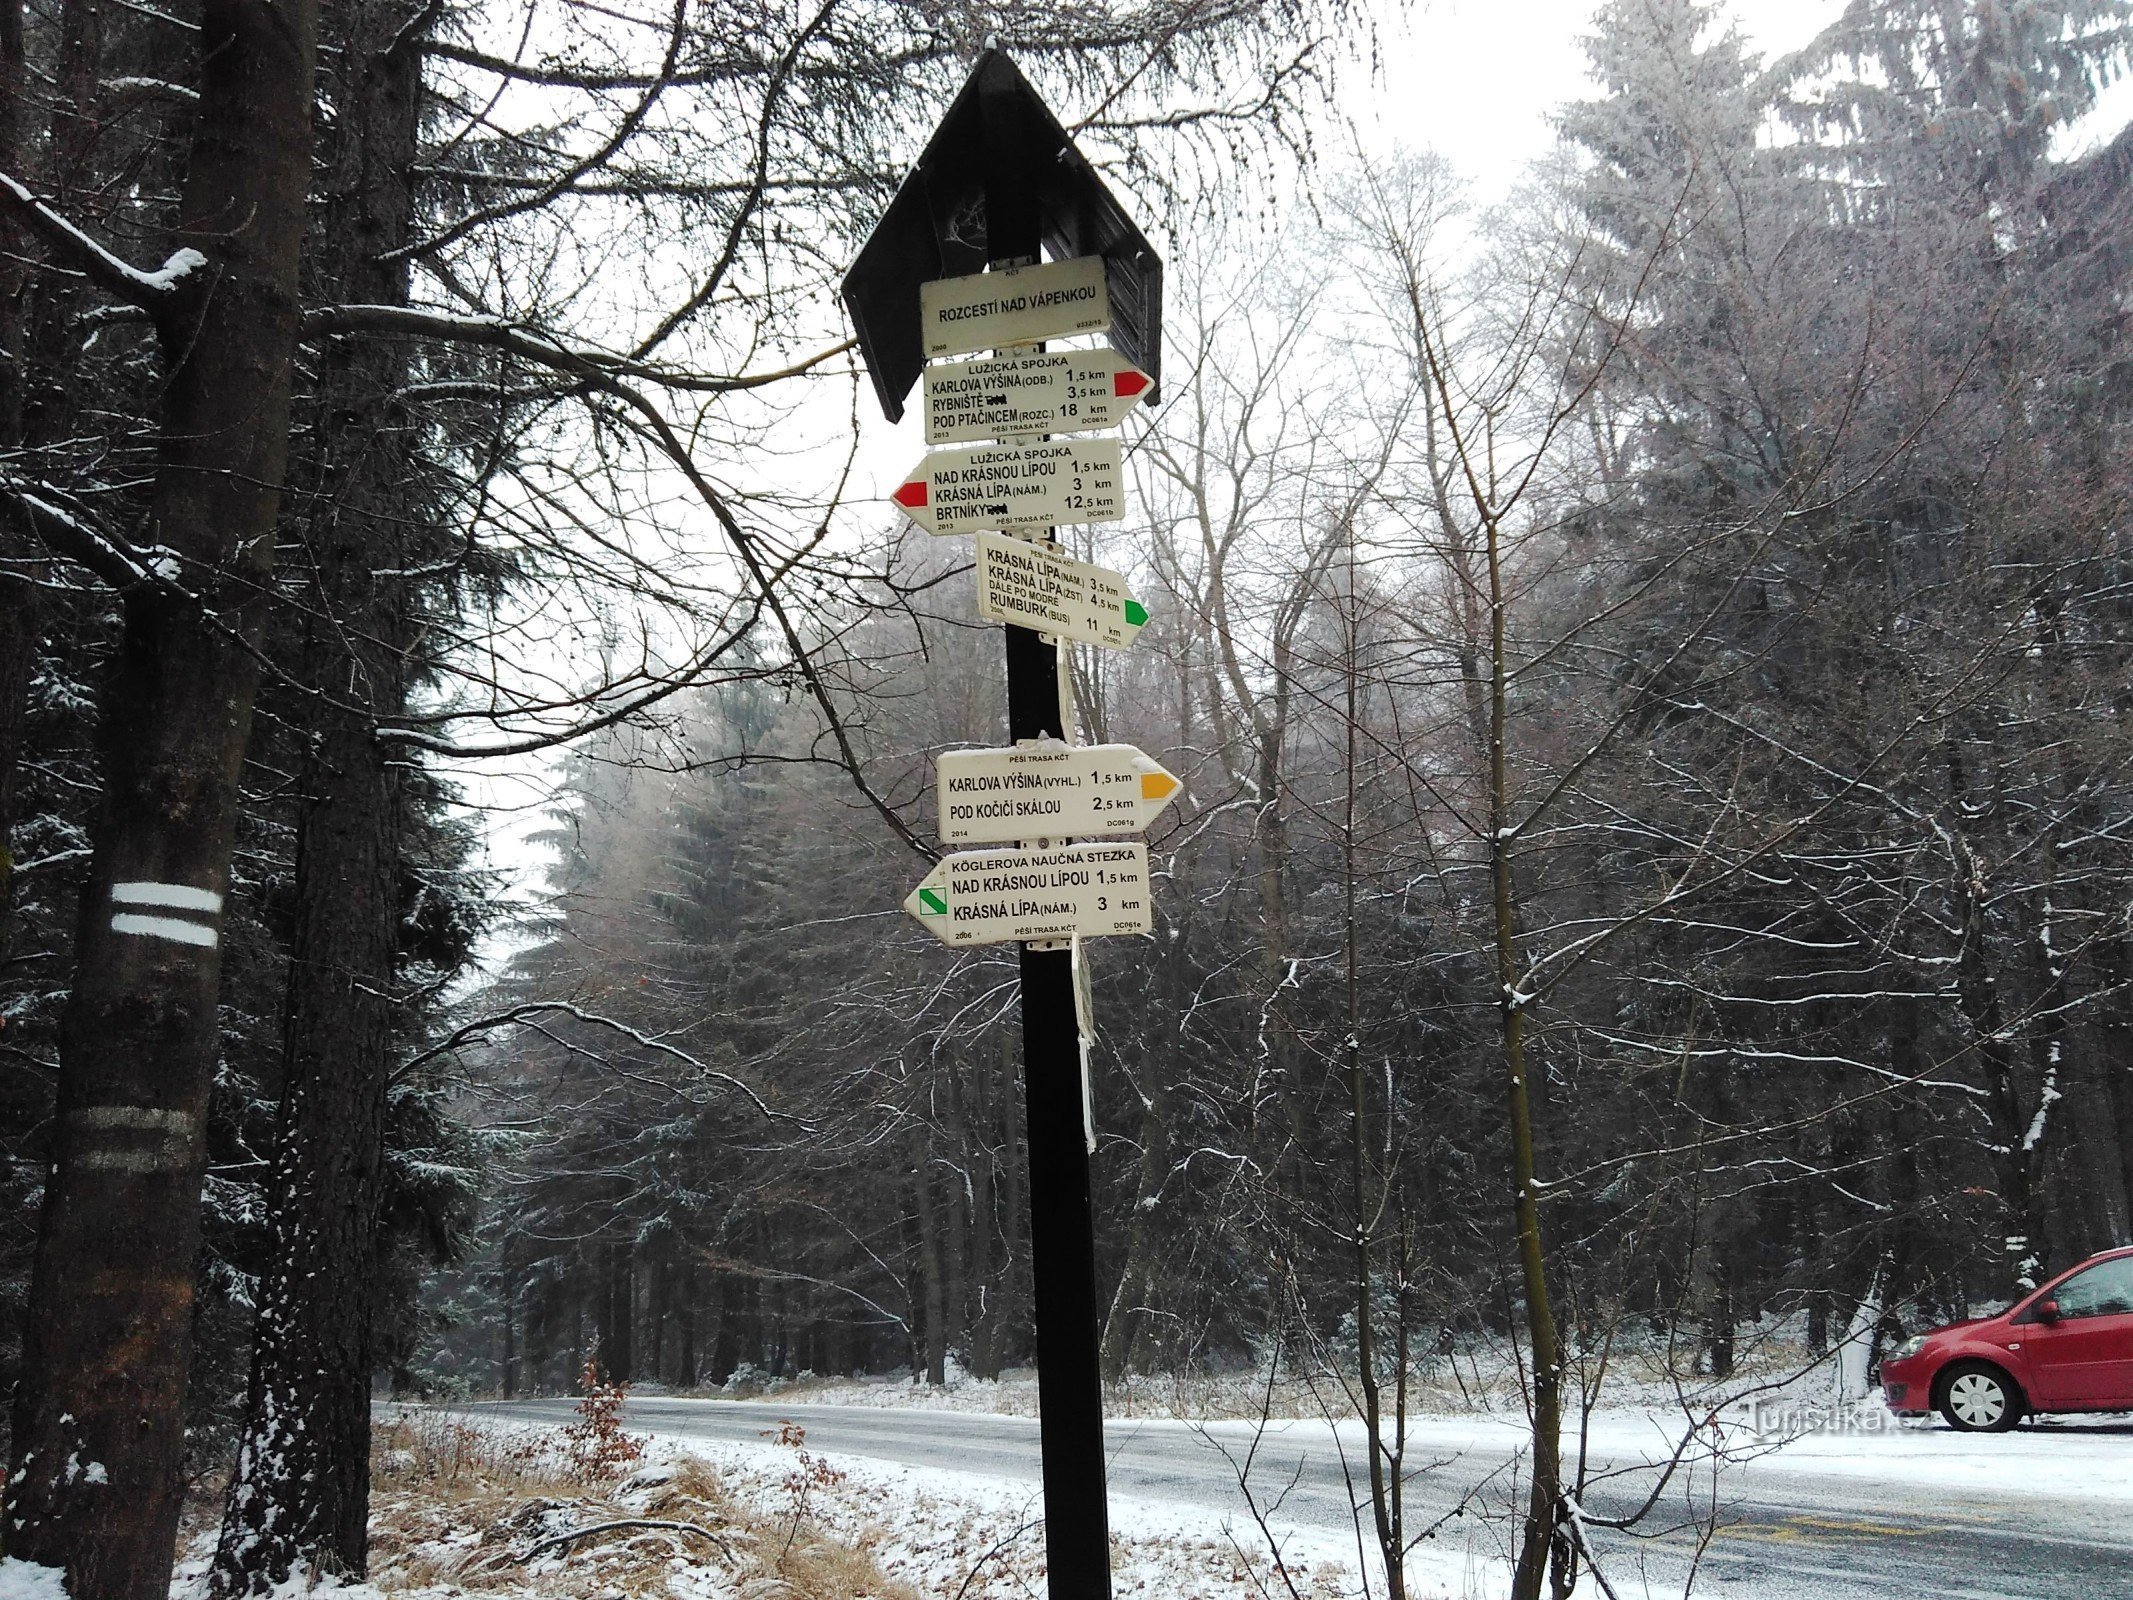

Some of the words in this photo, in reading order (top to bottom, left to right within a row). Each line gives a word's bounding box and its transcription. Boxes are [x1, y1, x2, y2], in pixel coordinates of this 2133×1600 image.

[939, 299, 998, 322] ROZCESTÍ
[1001, 297, 1027, 313] NAD
[1029, 286, 1096, 309] VÁPENKOU
[968, 360, 1018, 375] LUŽICKÁ
[1021, 357, 1068, 369] SPOJKA
[932, 379, 981, 394] KARLOVA
[1066, 369, 1086, 382] 1,5
[1088, 371, 1105, 380] km
[932, 394, 984, 411] RYBNIŠTĚ
[1067, 386, 1086, 398] 3,5
[1089, 388, 1106, 396] km
[933, 415, 956, 428] POD
[1059, 404, 1078, 417] 18
[1090, 405, 1107, 414] km
[1008, 423, 1033, 431] TRASA
[970, 449, 1021, 465] LUŽICKÁ
[1025, 447, 1072, 459] SPOJKA
[934, 470, 959, 484] NAD
[962, 465, 1018, 482] KRÁSNOU
[1022, 461, 1056, 477] LÍPOU
[1071, 460, 1091, 473] 1,5
[1093, 462, 1110, 471] km
[935, 485, 984, 502] KRÁSNÁ
[1073, 478, 1082, 490] 3
[1095, 480, 1112, 489] km
[937, 502, 987, 520] BRTNÍKY
[1064, 495, 1093, 509] 12,5
[1096, 497, 1113, 506] km
[1014, 515, 1038, 523] TRASA
[1039, 514, 1054, 522] KČT
[987, 548, 1034, 573] KRÁSNÁ
[1090, 577, 1105, 593] 3,5
[1106, 584, 1118, 596] km
[988, 565, 1036, 589] KRÁSNÁ
[1091, 594, 1106, 609] 4,5
[1108, 600, 1120, 612] km
[989, 579, 1012, 594] DÁLE
[1014, 587, 1027, 599] PO
[1029, 592, 1059, 607] MODRÉ
[1087, 617, 1098, 631] 11
[1109, 627, 1121, 637] km
[1009, 755, 1027, 763] PĚŠÍ
[949, 776, 1001, 793] KARLOVA
[1091, 771, 1112, 785] 1,5
[1115, 773, 1132, 782] km
[950, 805, 973, 819] POD
[976, 800, 1014, 818] KOČIČÍ
[1016, 798, 1061, 816] SKÁLOU
[1092, 797, 1113, 811] 2,5
[1116, 800, 1134, 809] km
[952, 858, 1029, 872] KÖGLEROVA
[1031, 852, 1084, 866] NAUČNÁ
[1087, 850, 1136, 862] STEZKA
[952, 879, 980, 894] NAD
[983, 874, 1047, 892] KRÁSNOU
[1051, 869, 1089, 886] LÍPOU
[1097, 869, 1117, 884] 1,5
[1120, 872, 1138, 883] km
[953, 903, 1009, 921] KRÁSNÁ
[1097, 897, 1107, 911] 3
[1121, 900, 1139, 909] km
[1014, 927, 1032, 935] PĚŠÍ
[1033, 926, 1059, 934] TRASA
[1061, 924, 1076, 932] KČT
